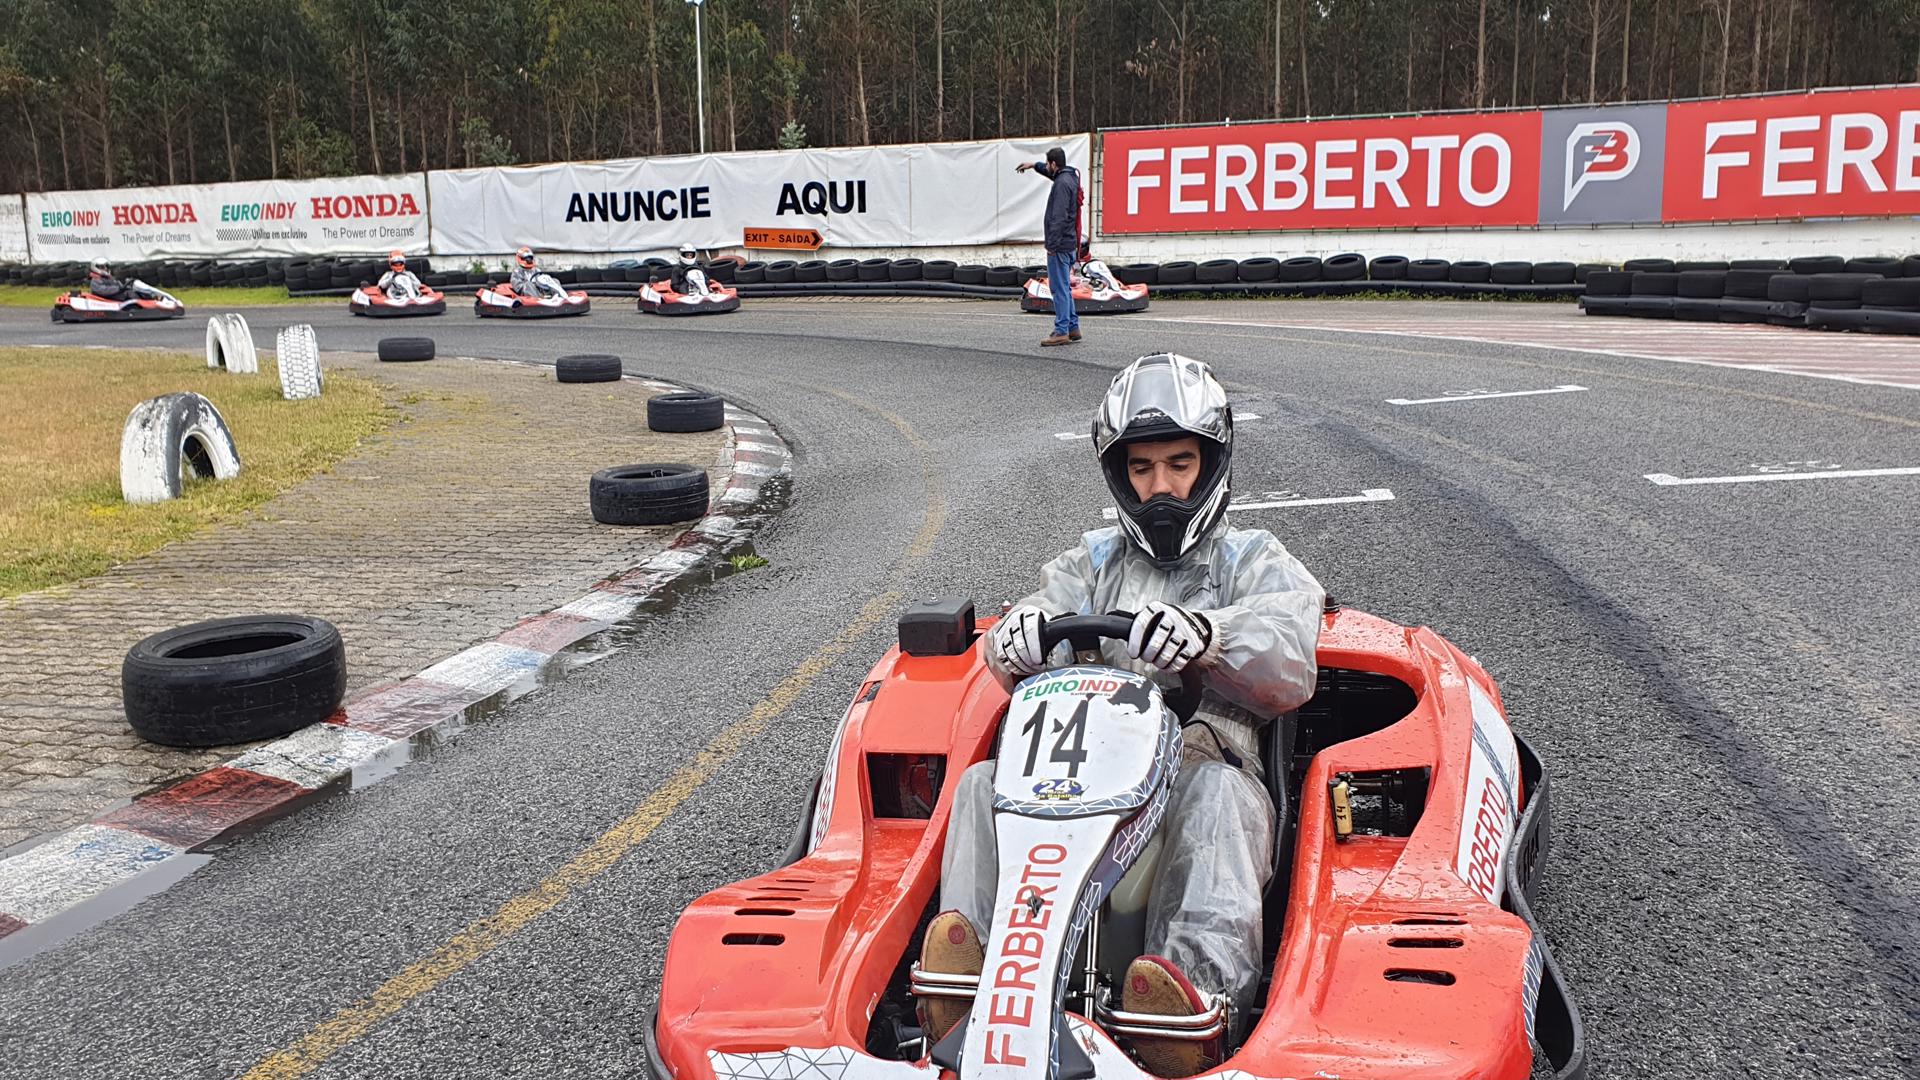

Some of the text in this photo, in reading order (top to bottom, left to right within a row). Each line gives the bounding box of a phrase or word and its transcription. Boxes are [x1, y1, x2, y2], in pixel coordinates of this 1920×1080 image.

[1127, 132, 1511, 215] FERBERTO
[311, 193, 420, 218] HONDA
[565, 180, 866, 222] ANUNCIE AQUI
[42, 210, 100, 227] EUROINDY
[112, 203, 197, 225] HONDA
[221, 202, 296, 221] EUROINDY
[122, 231, 191, 244] The Power of Dreams
[322, 226, 414, 238] The Power of Dreams
[745, 233, 769, 242] EXIT
[778, 232, 811, 244] SAÍDA
[1023, 680, 1126, 701] EUROIND
[1022, 700, 1089, 778] 14
[1039, 780, 1071, 793] 24
[1336, 805, 1347, 820] 14
[984, 844, 1067, 1067] FERBERTO
